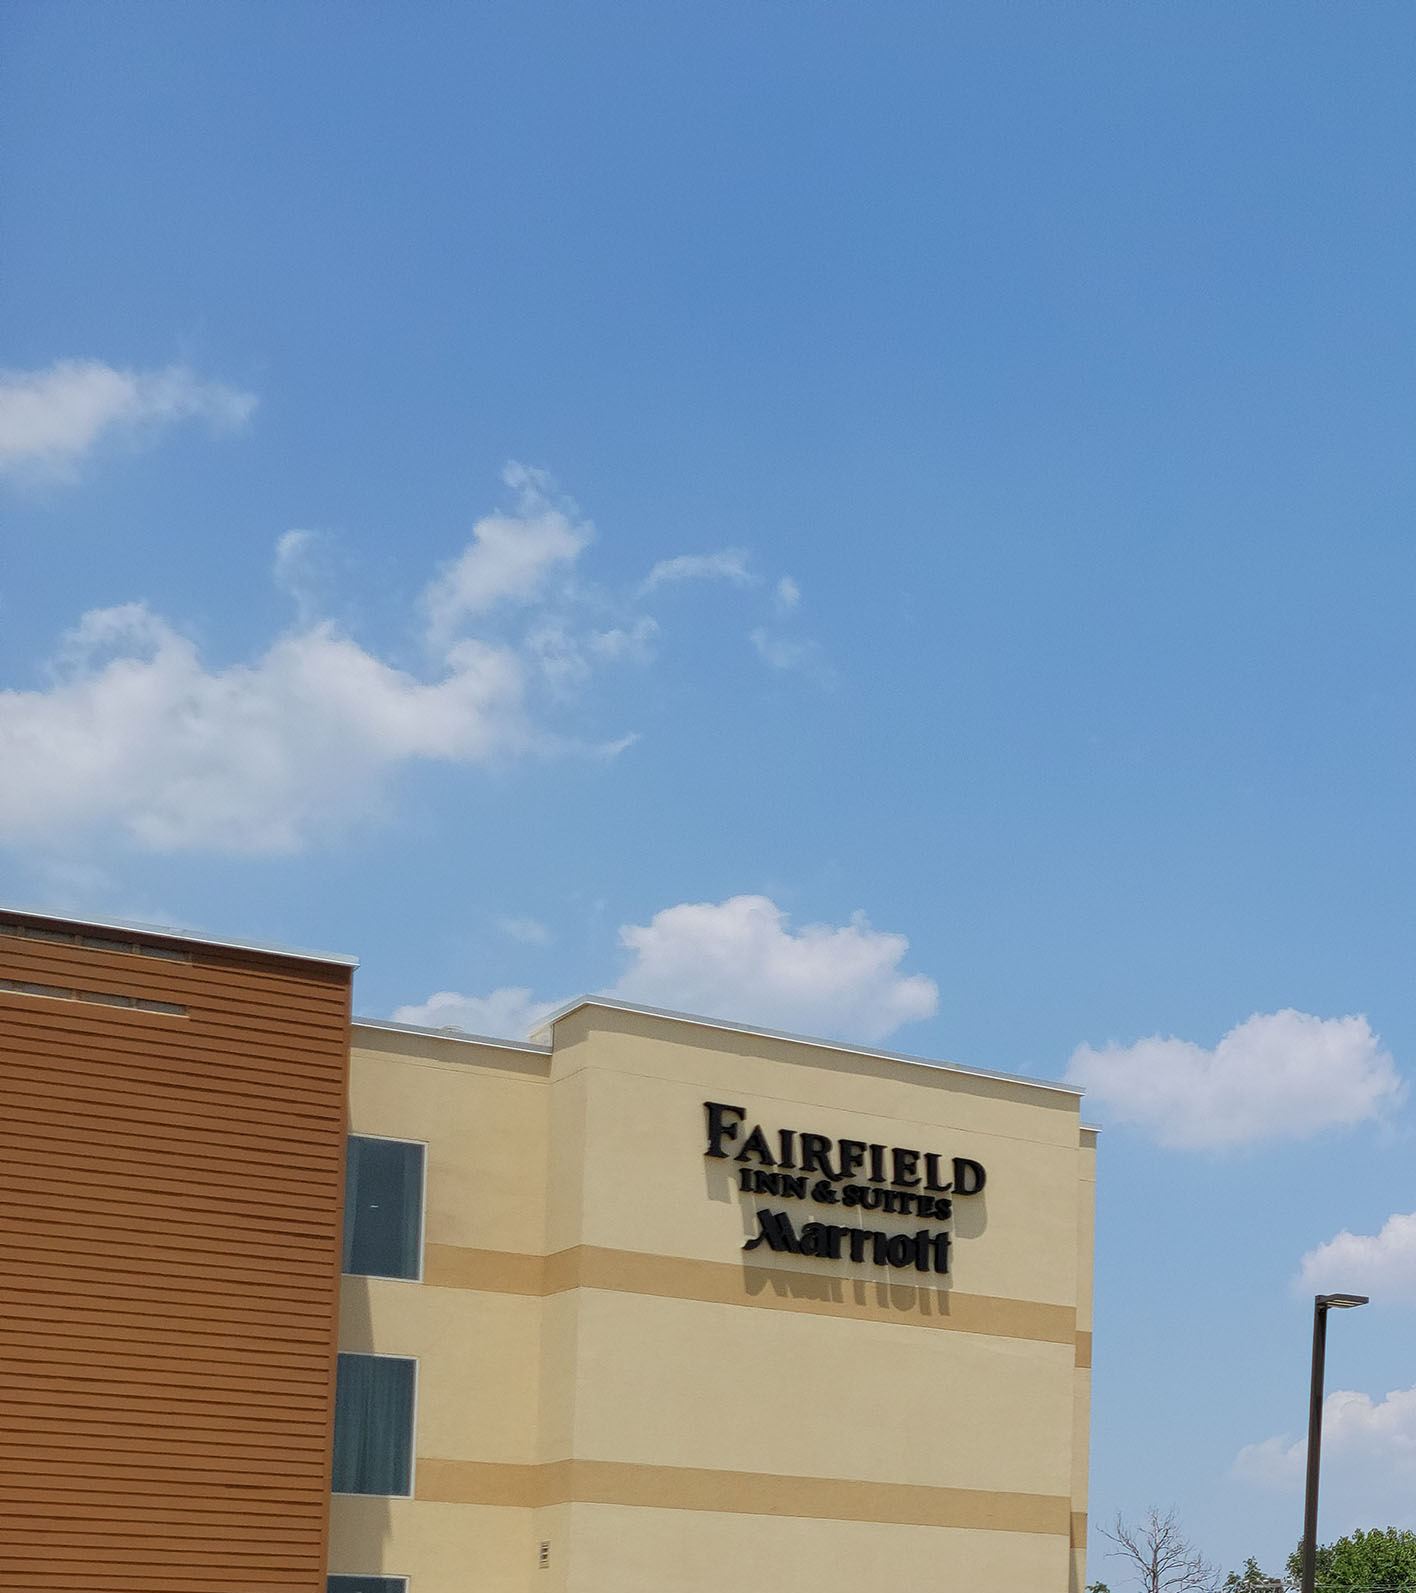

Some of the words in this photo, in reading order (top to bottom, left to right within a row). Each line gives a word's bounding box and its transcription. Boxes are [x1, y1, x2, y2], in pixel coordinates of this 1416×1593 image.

[703, 1101, 987, 1195] FAIRFIELD
[739, 1168, 808, 1200] INN
[811, 1180, 841, 1205] &
[842, 1184, 953, 1221] SUITES
[741, 1208, 953, 1275] Marriott
